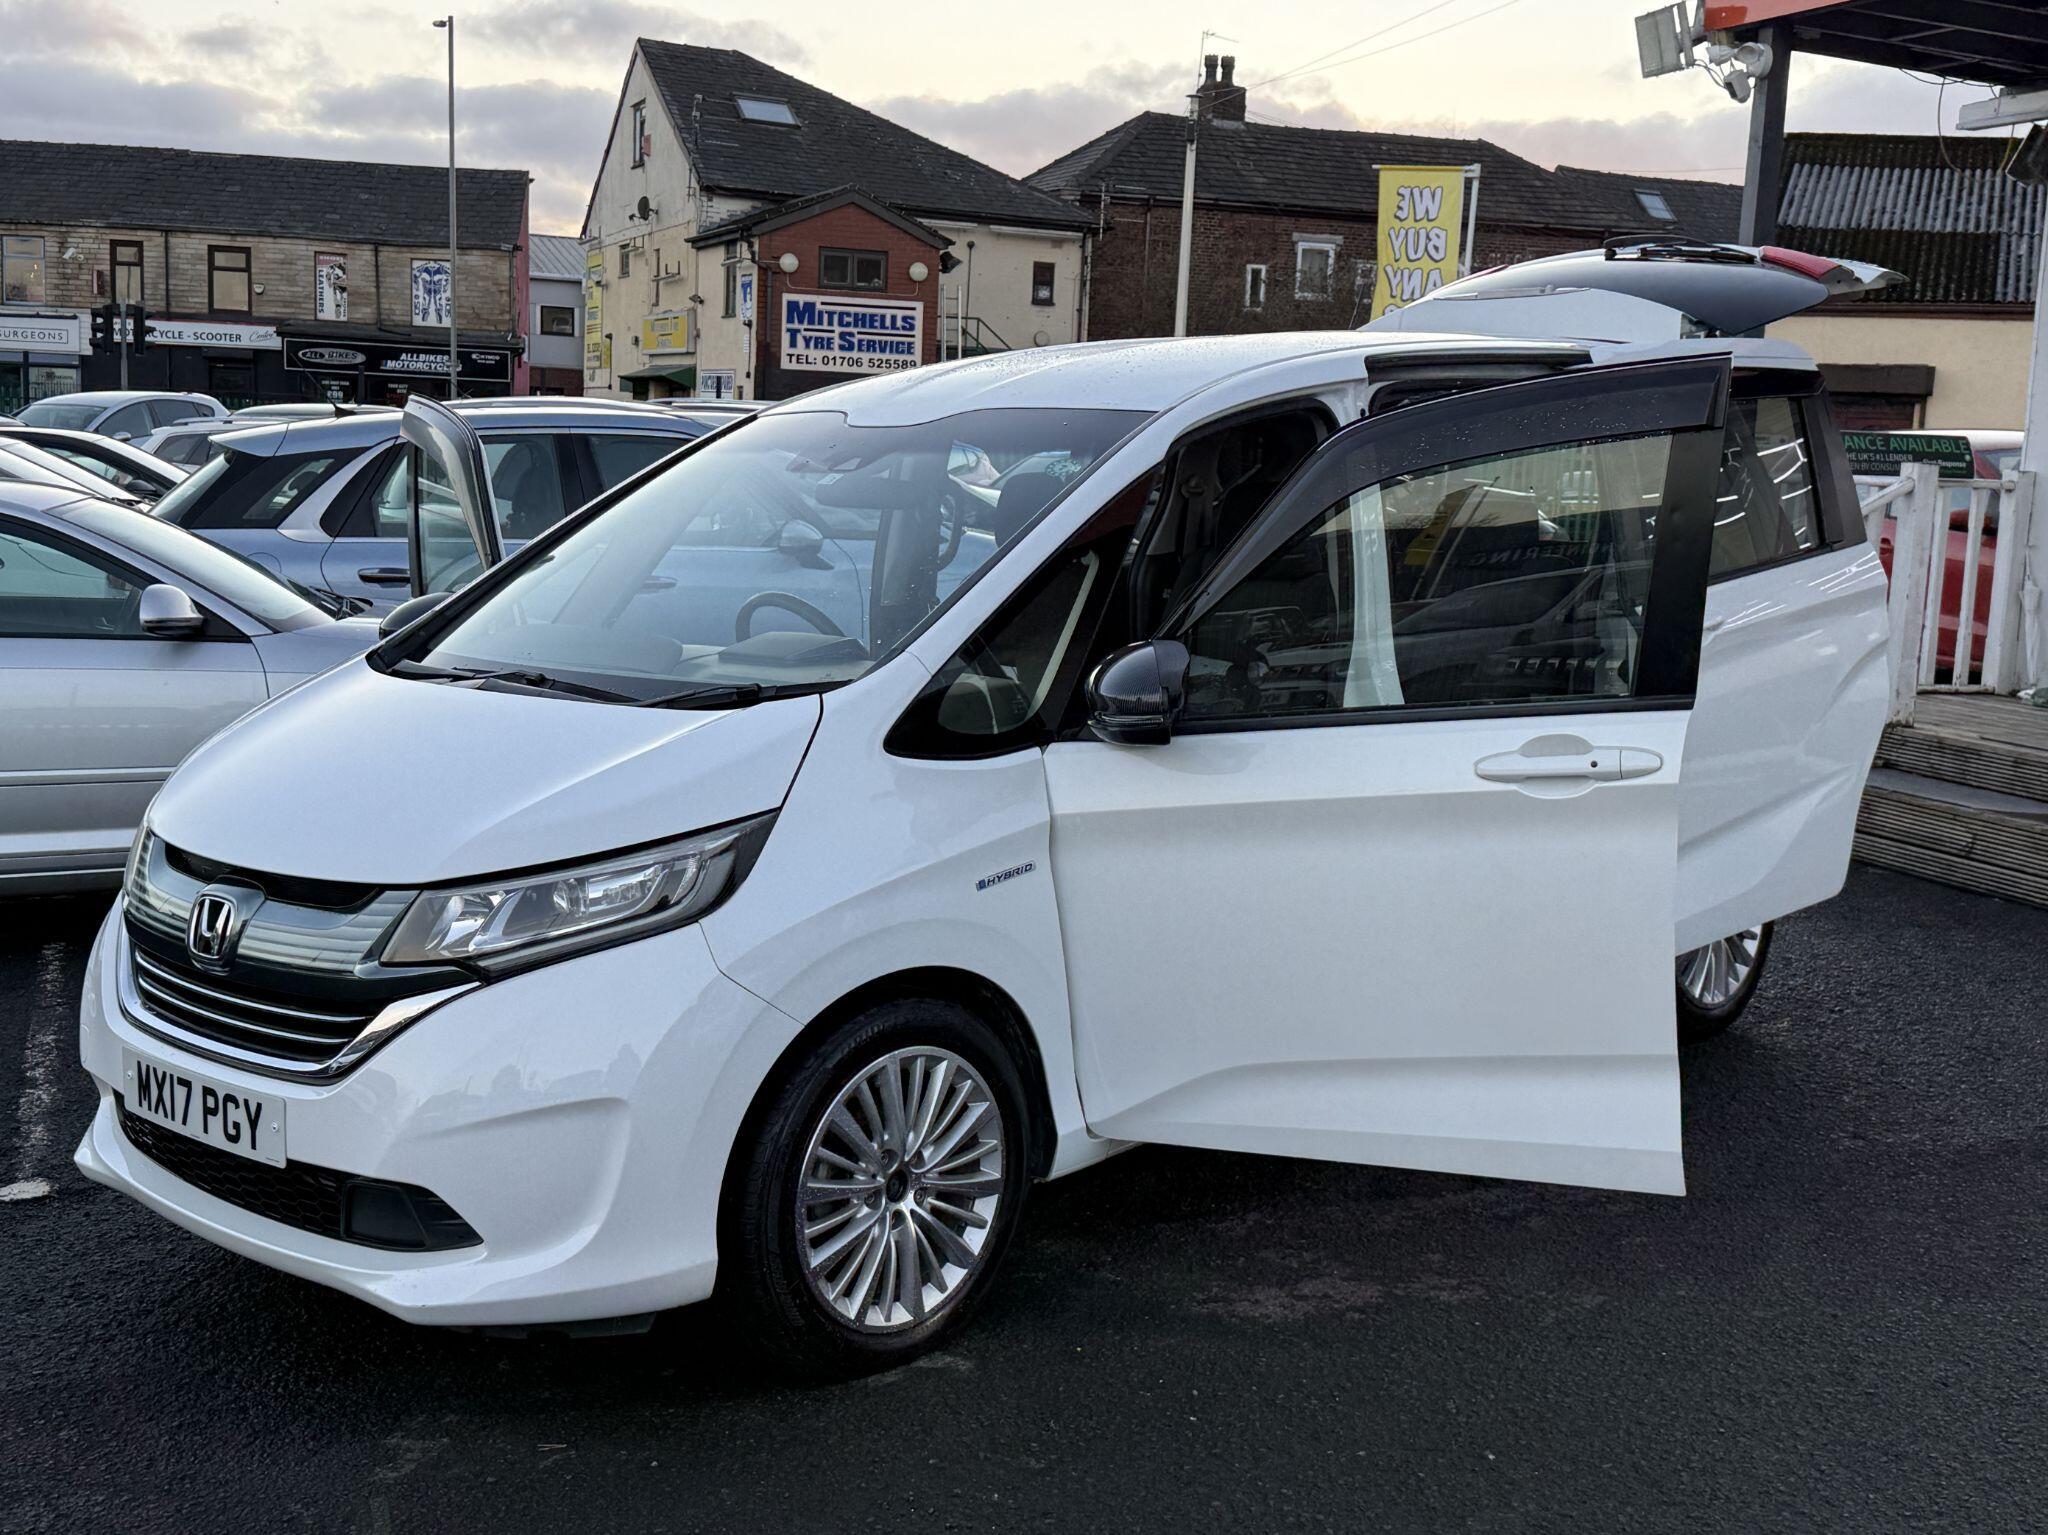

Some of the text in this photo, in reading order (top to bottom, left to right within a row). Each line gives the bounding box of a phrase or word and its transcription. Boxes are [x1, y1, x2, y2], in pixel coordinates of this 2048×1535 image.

[786, 300, 916, 332] MITCHELLS
[193, 331, 242, 343] SCOOTER
[786, 328, 915, 355] TYRE SERVICE
[305, 351, 358, 360] ALL BIKES
[400, 353, 450, 362] ALLBIKES
[786, 353, 917, 370] TEL: 01706 525589
[386, 360, 462, 371] MOTORCYCLS
[1844, 434, 1971, 453] ANCE AVAILABLE
[1885, 453, 1913, 462] LENDER
[1870, 463, 1901, 471] CONSUM
[987, 863, 1033, 886] HYBRID
[137, 1060, 263, 1150] MX17 PGY
